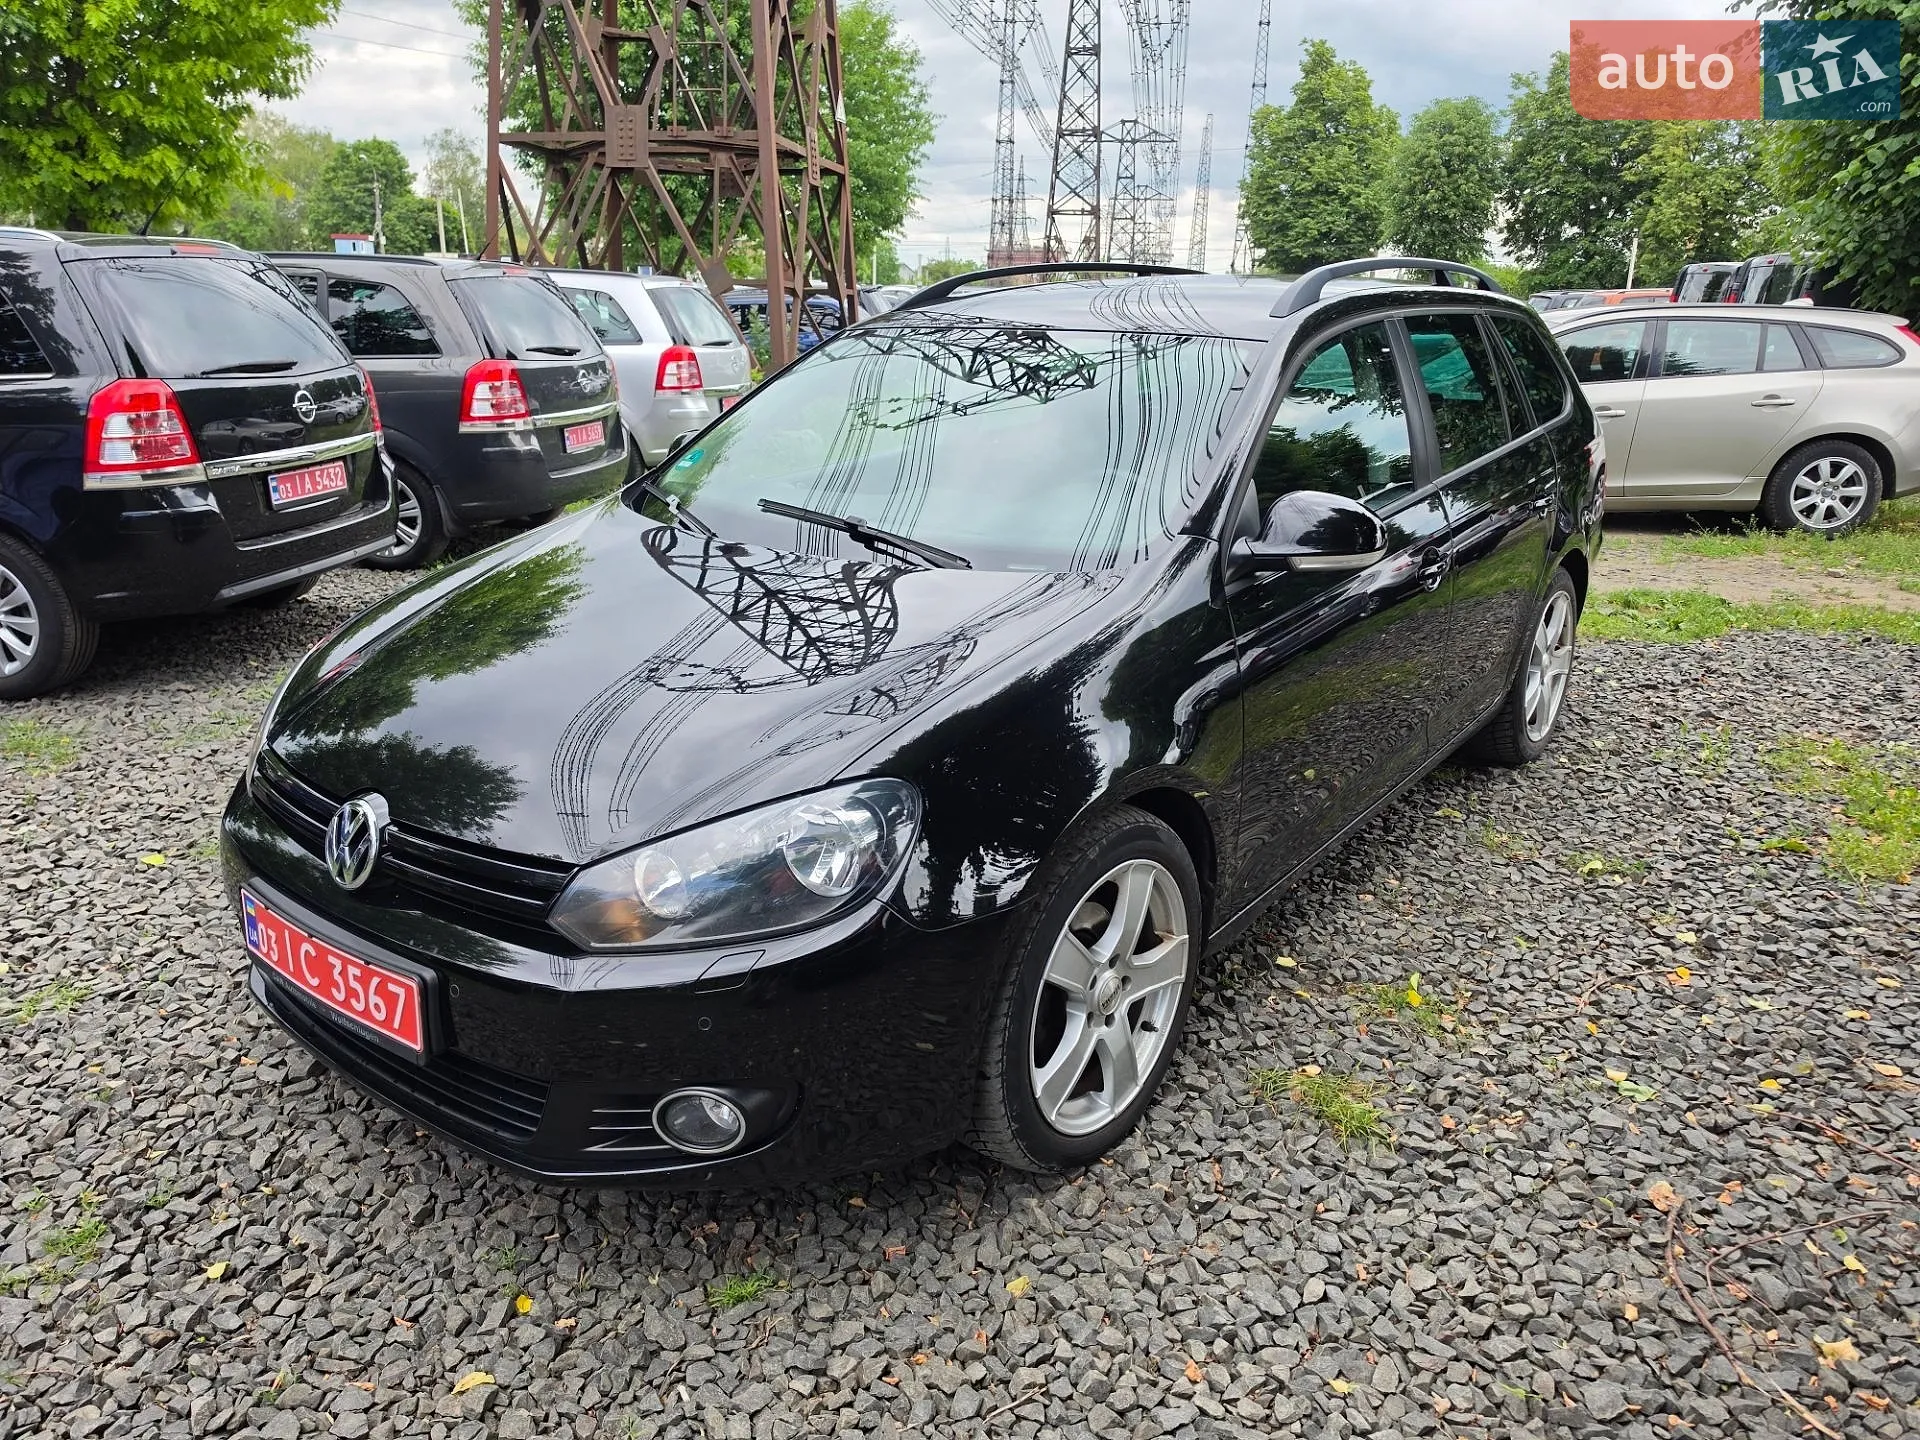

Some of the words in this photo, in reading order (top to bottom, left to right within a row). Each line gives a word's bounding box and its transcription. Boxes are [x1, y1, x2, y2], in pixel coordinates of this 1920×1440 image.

[279, 484, 293, 499] 03
[315, 467, 343, 490] 5432
[258, 922, 278, 963] 03
[328, 955, 406, 1030] 3567
